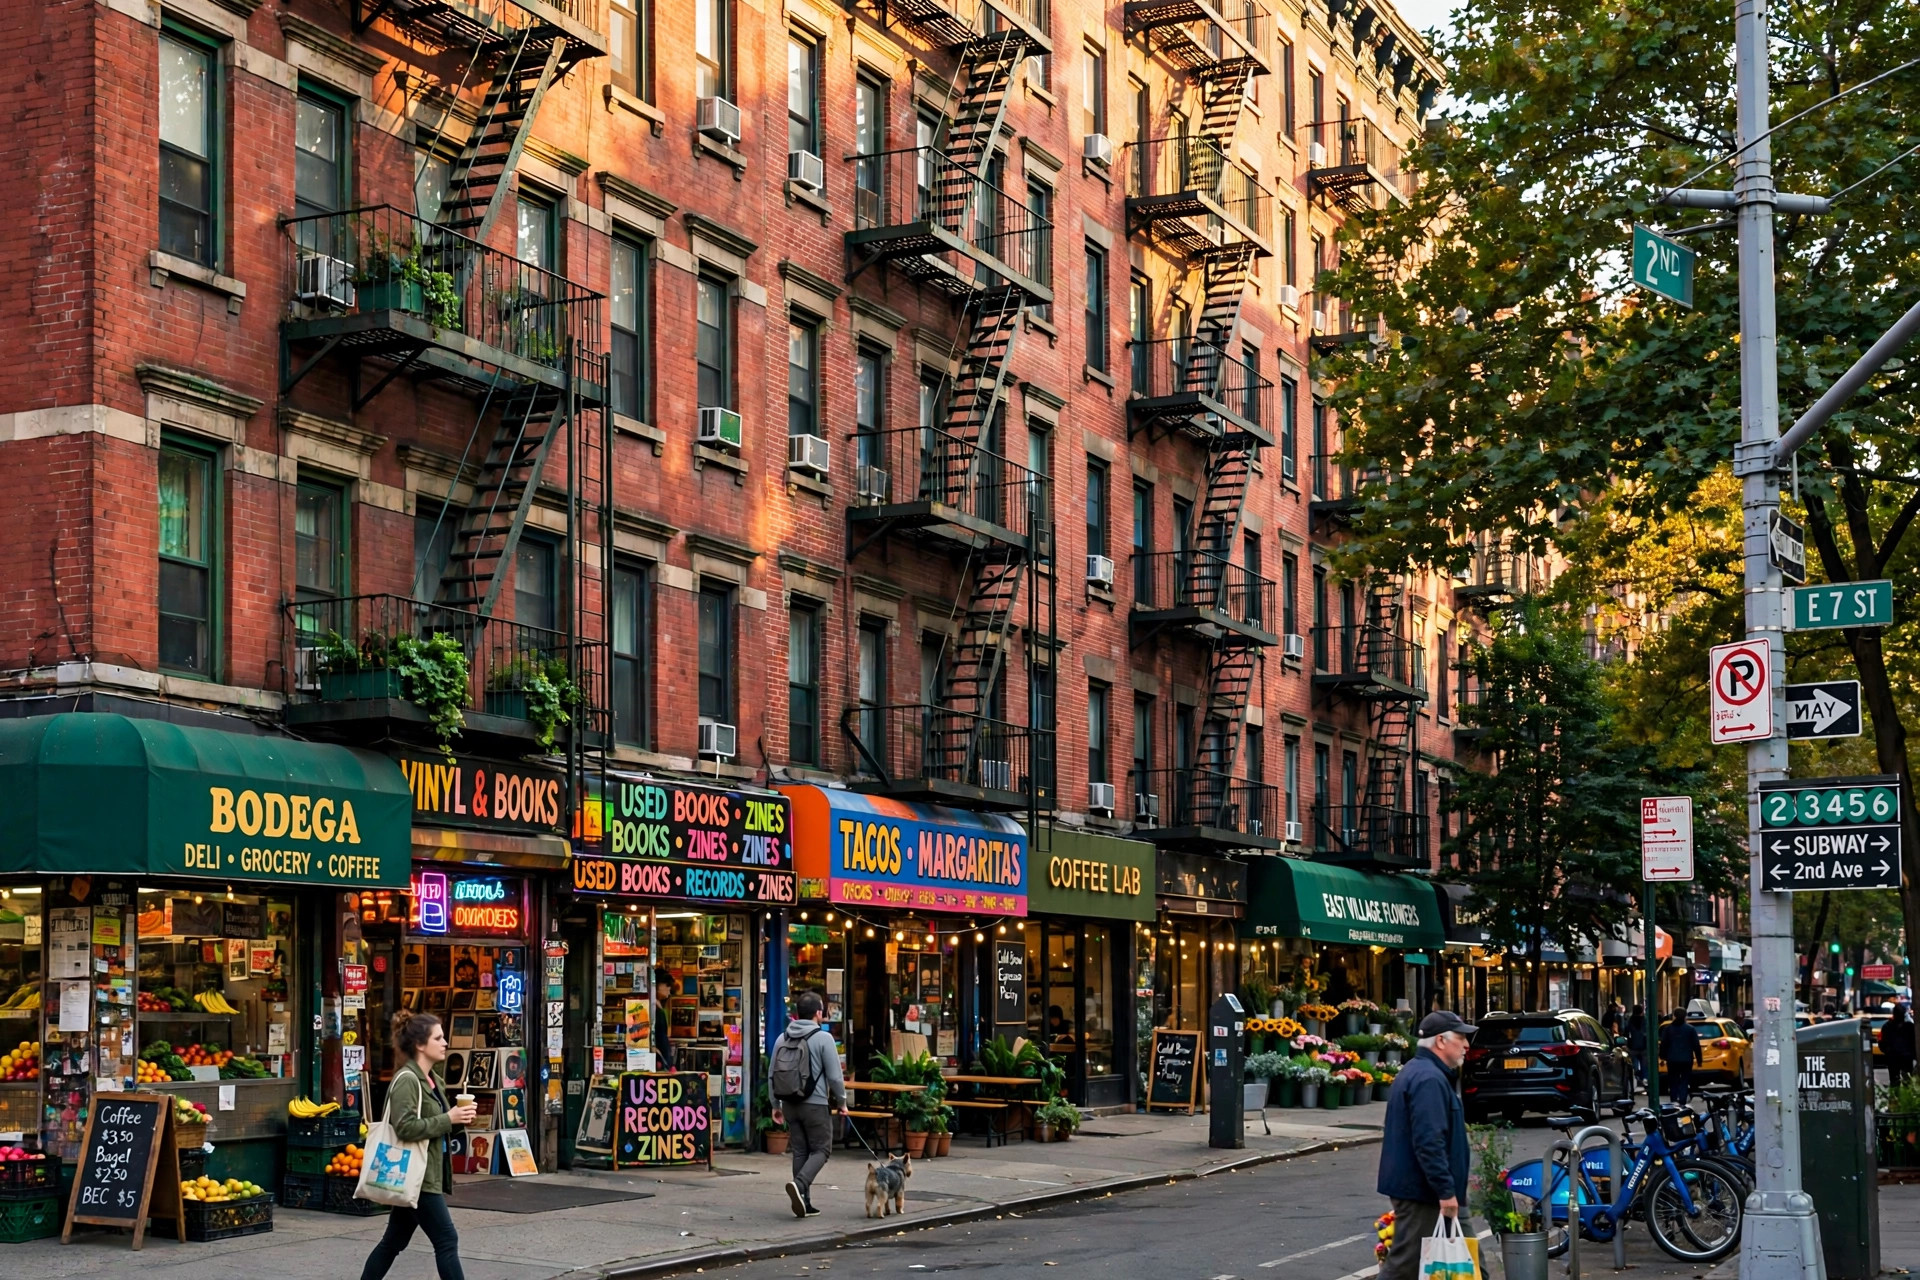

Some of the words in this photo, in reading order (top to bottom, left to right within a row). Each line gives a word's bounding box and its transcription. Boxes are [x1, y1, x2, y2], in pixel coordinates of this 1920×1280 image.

[1646, 239, 1681, 286] 2ND
[1808, 593, 1821, 622] E
[1829, 592, 1843, 620] 7
[1854, 589, 1878, 618] ST
[401, 759, 467, 814] VINYL
[472, 769, 488, 817] &
[494, 773, 559, 826] BOOKS
[621, 783, 668, 820] USED
[674, 790, 730, 828] BOOKS
[745, 800, 785, 834] ZINES
[1770, 796, 1787, 821] 2
[1804, 794, 1820, 819] 3
[1826, 794, 1844, 817] 4
[1849, 793, 1866, 817] 5
[1872, 792, 1889, 816] 6
[209, 786, 361, 844] BODEGA
[612, 820, 670, 858] BOOKS
[687, 829, 728, 861] ZINES
[742, 834, 780, 866] ZINES
[839, 818, 902, 876] TACOS
[917, 829, 1022, 887] MARGARITAS
[1793, 833, 1869, 856] SUBWAY
[184, 843, 220, 870] DELI
[240, 847, 311, 875] GROCERY
[328, 854, 381, 880] COFFEE
[1049, 855, 1109, 893] COFFEE
[1113, 864, 1141, 896] LAB
[1793, 860, 1826, 880] 2nd
[1830, 859, 1864, 879] Ave
[621, 863, 671, 894] BOOKS
[685, 867, 745, 899] RECORDS
[757, 873, 793, 902] ZINES
[1322, 892, 1347, 919] EAST
[1346, 896, 1383, 924] VILLAGE
[1804, 1056, 1826, 1071] THE
[629, 1078, 682, 1105] USED
[100, 1105, 142, 1125] Coffee
[624, 1105, 708, 1133] RECORDS
[95, 1145, 132, 1168] Bagel
[637, 1133, 696, 1161] ZINES
[81, 1186, 110, 1205] BEC
[117, 1188, 136, 1208] $5
